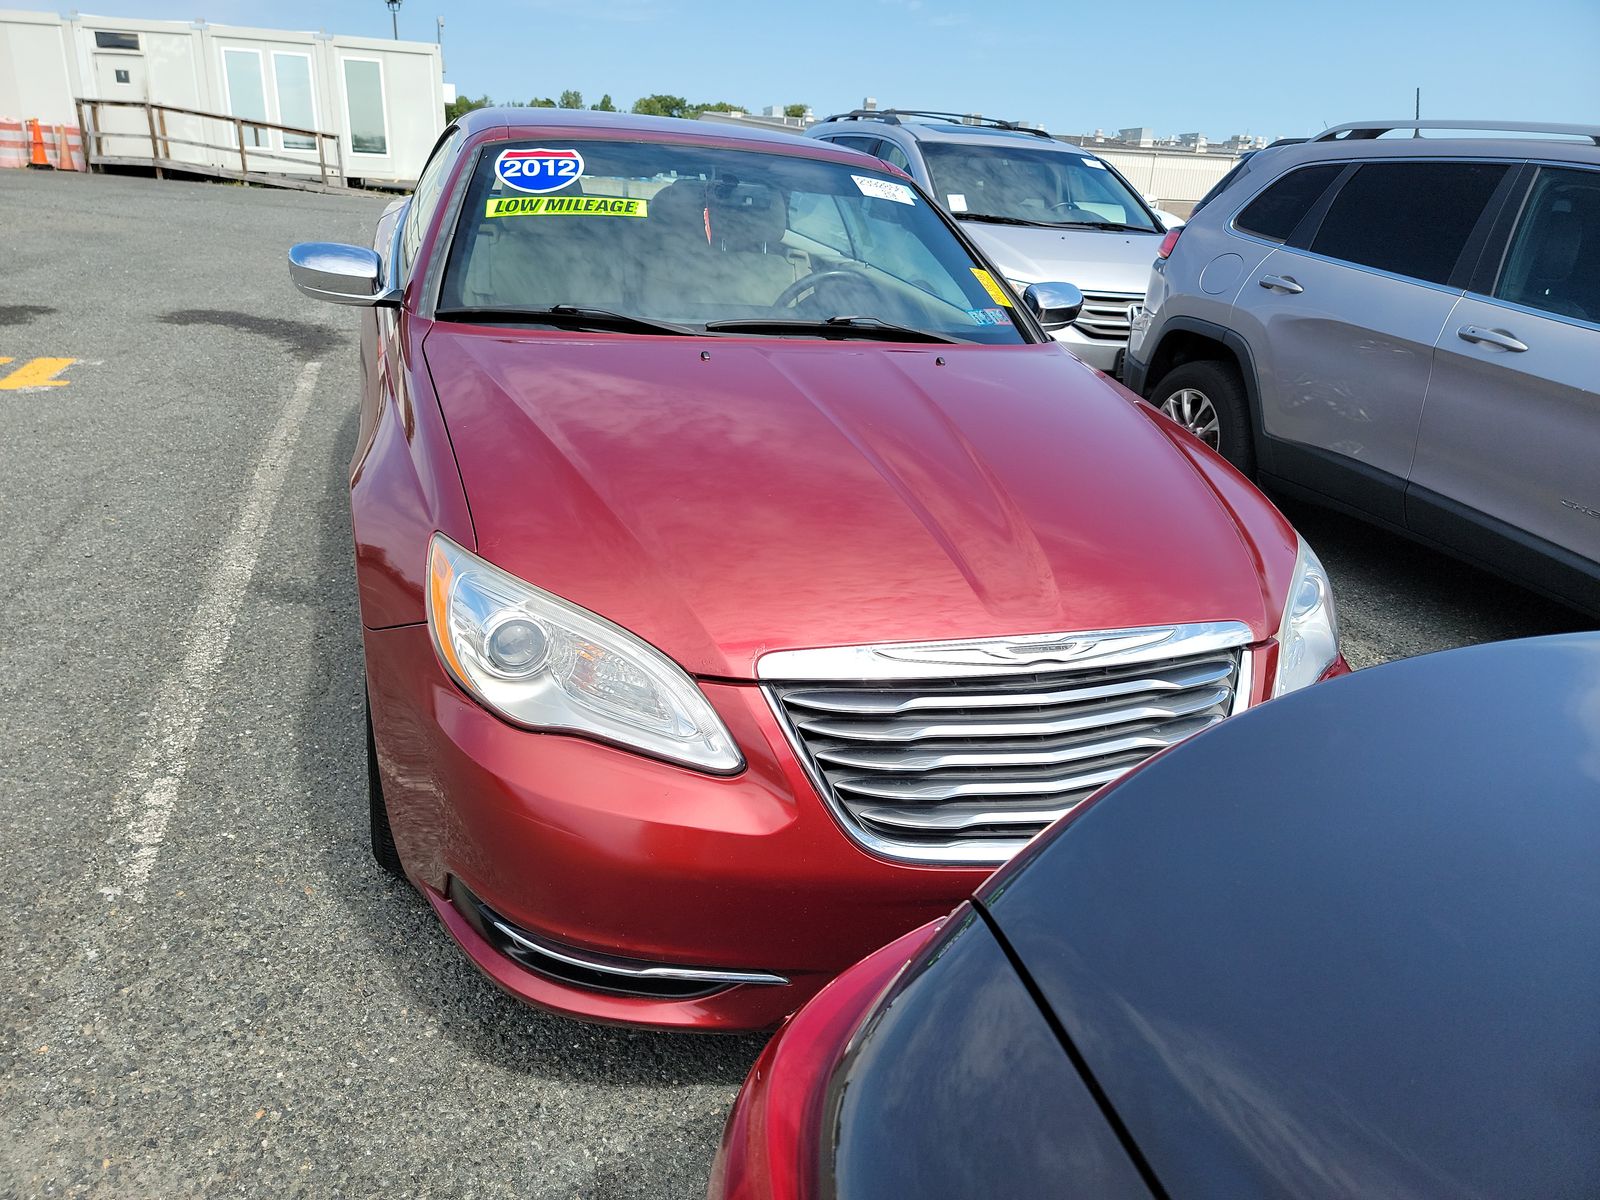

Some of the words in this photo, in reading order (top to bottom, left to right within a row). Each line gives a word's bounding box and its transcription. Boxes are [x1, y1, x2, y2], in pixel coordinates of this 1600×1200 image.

[503, 159, 576, 177] 2012
[494, 199, 543, 214] LOW
[544, 199, 638, 214] MILEAGE
